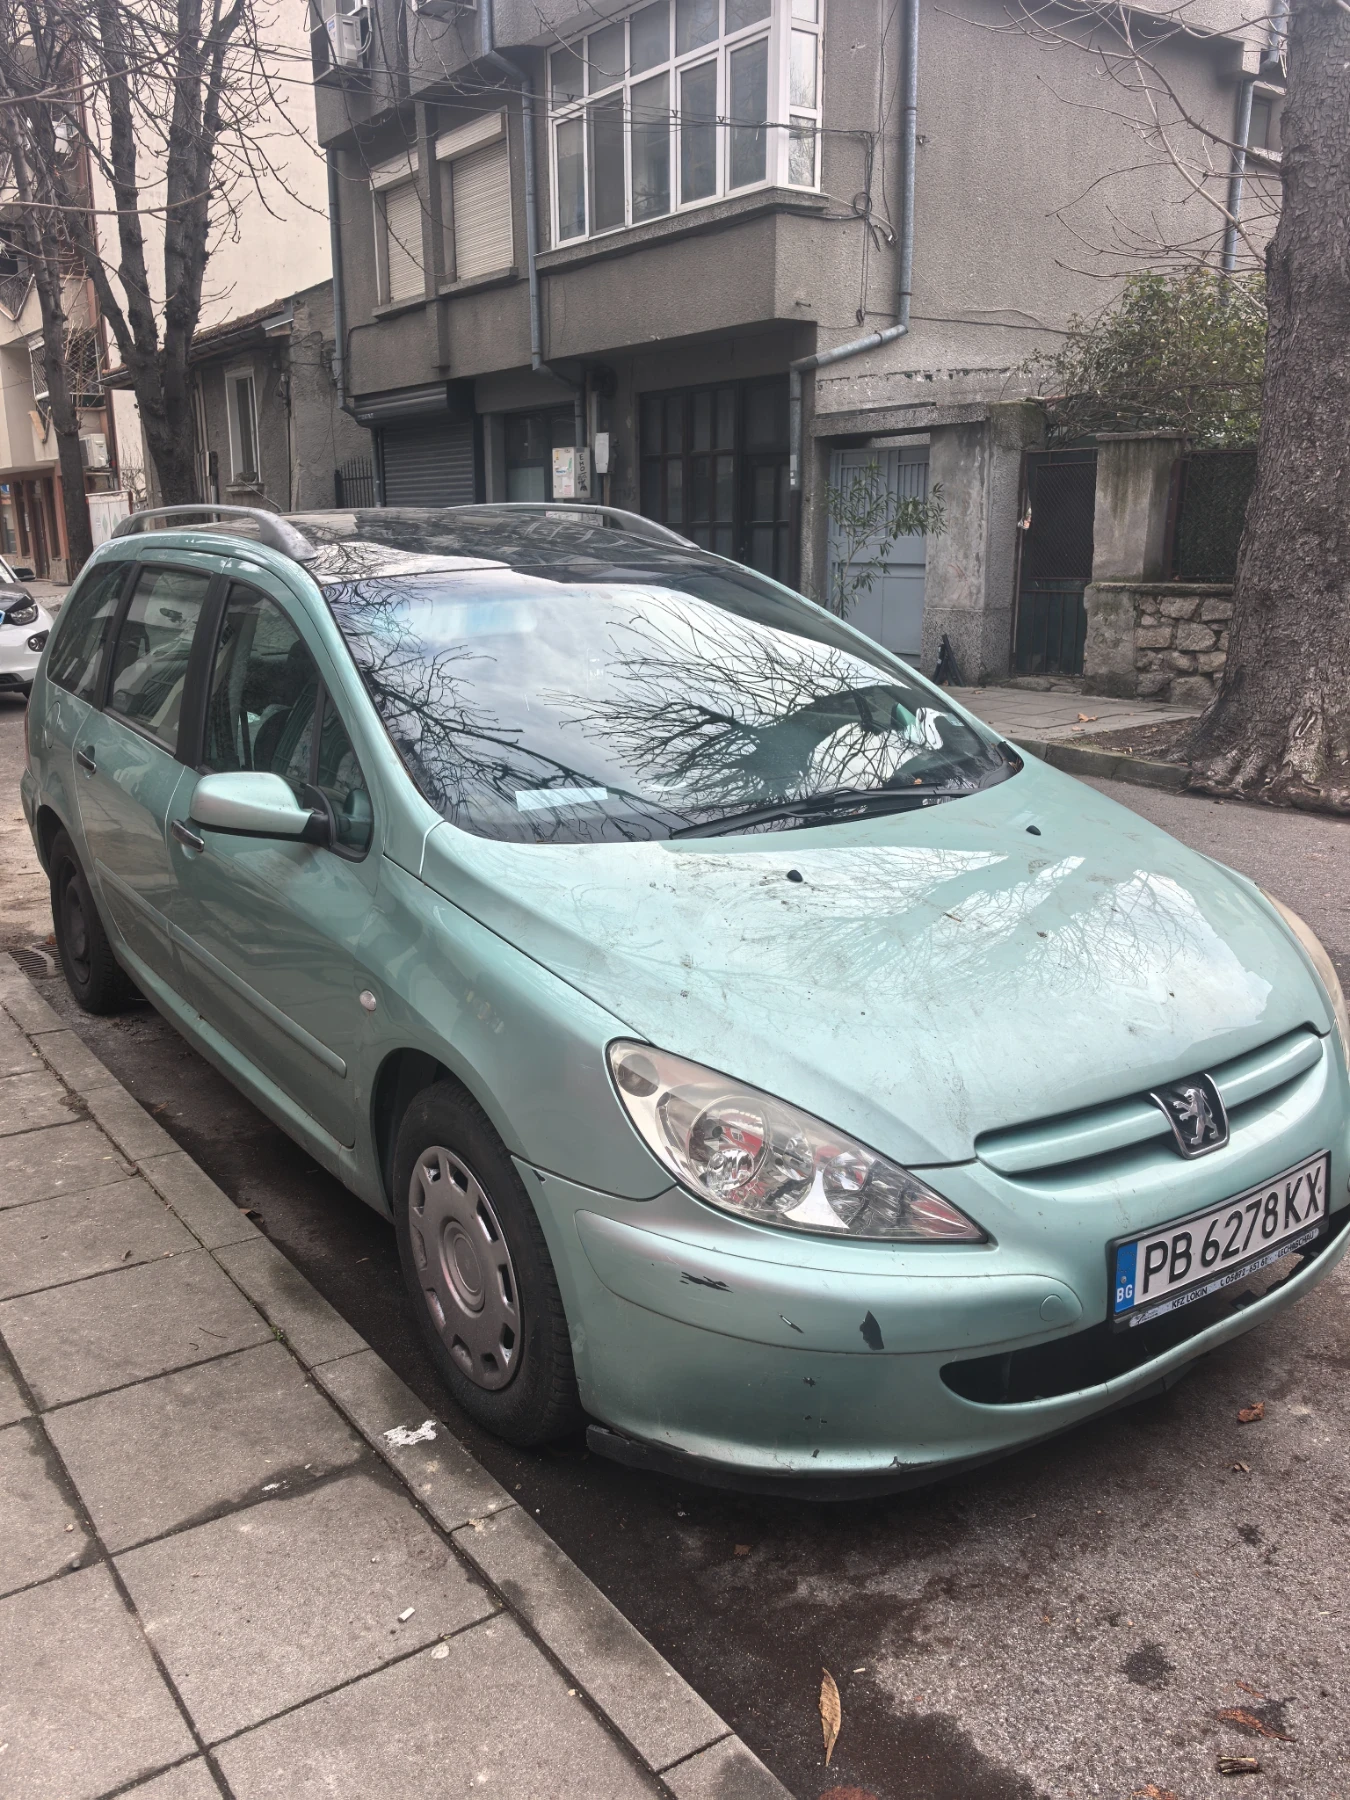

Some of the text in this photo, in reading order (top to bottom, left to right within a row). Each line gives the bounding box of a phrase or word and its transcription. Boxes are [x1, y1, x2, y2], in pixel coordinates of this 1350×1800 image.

[1142, 1166, 1321, 1295] PB 6278 KX
[1117, 1284, 1133, 1302] BG
[1172, 1297, 1185, 1309] KFZ
